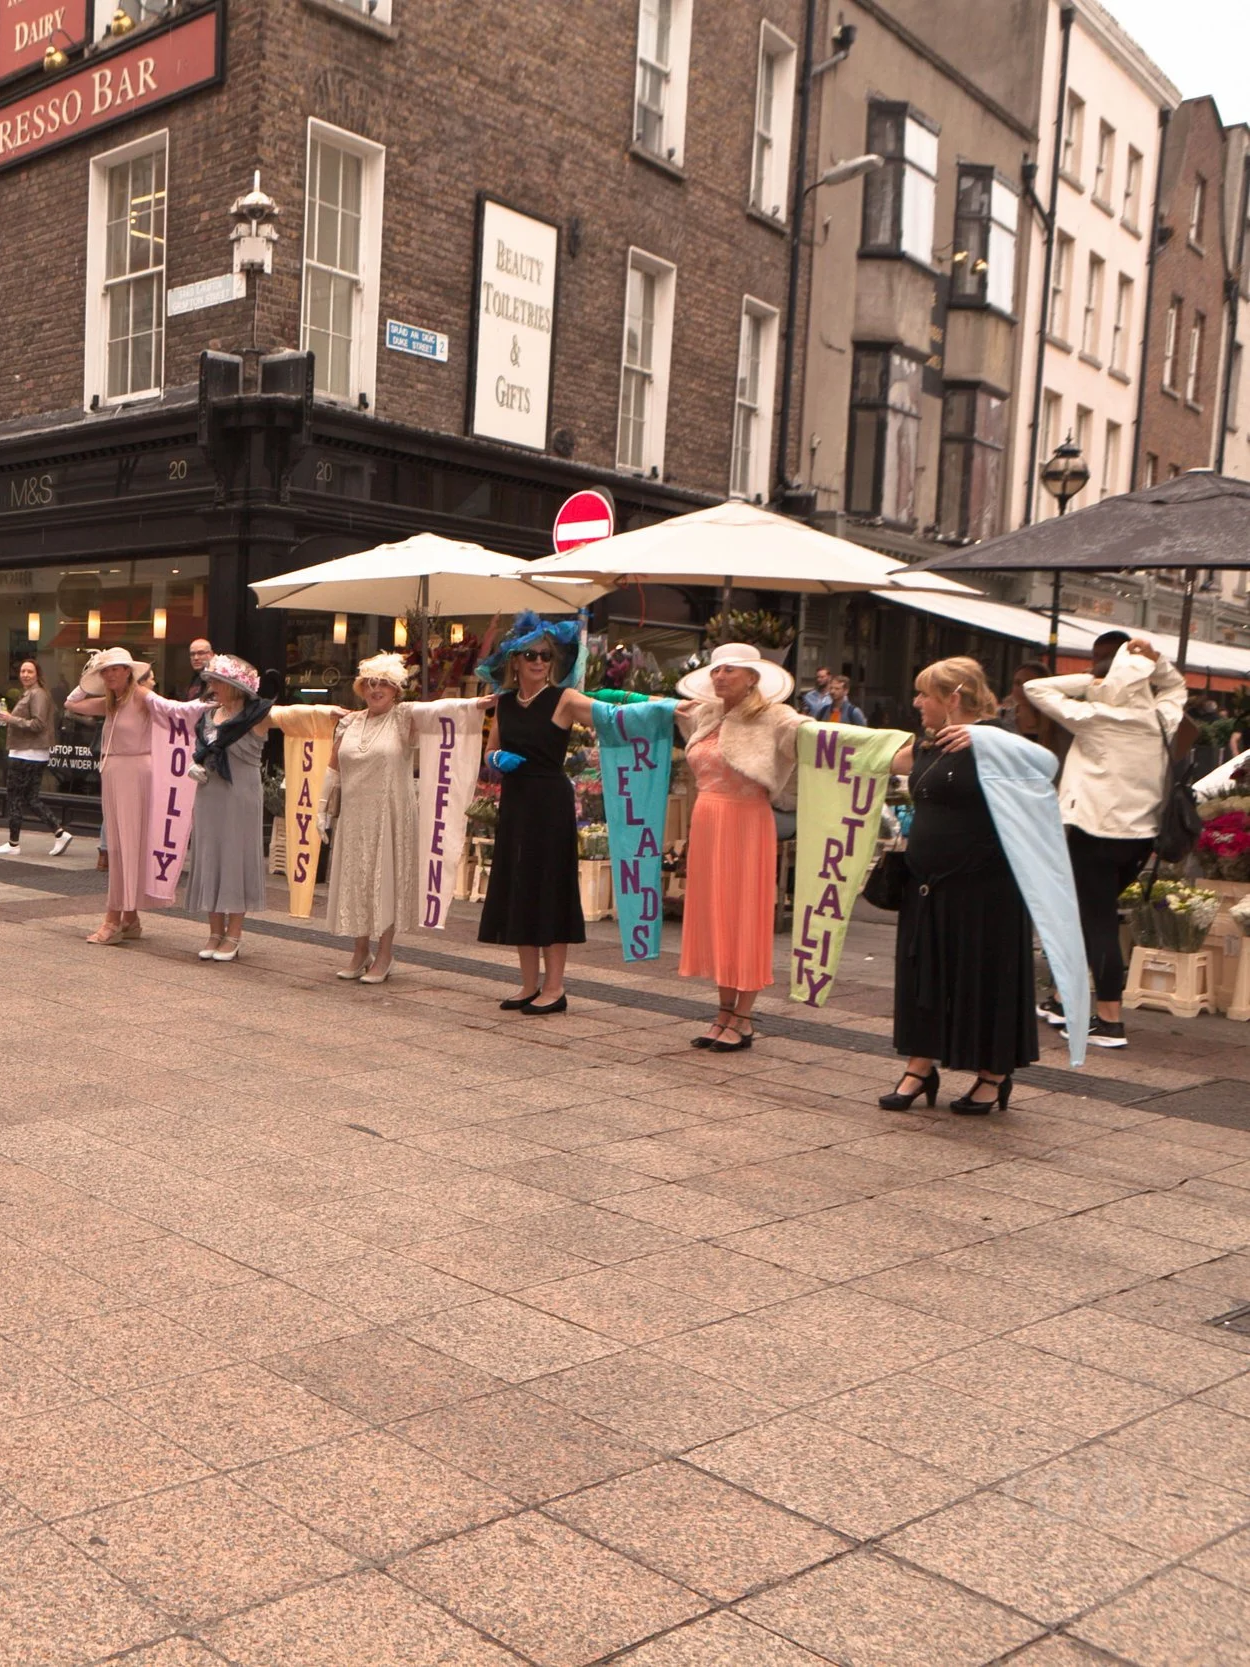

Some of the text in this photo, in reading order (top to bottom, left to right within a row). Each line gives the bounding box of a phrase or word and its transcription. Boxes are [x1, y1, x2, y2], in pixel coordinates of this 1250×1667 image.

[14, 7, 65, 52] DAIRY
[91, 57, 158, 116] BAR
[496, 238, 544, 286] BEAUTY
[483, 280, 551, 335] TOILETRIES
[392, 335, 433, 354] DUKE STREET
[439, 341, 445, 354] 2
[509, 334, 521, 368] &
[495, 375, 531, 414] GIFTS
[168, 460, 187, 480] 20
[316, 460, 333, 482] 20
[10, 474, 53, 509] M&S
[47, 757, 61, 768] JOY
[62, 758, 69, 768] A
[70, 759, 92, 770] WIDER
[49, 744, 73, 755] OFTOP
[153, 717, 190, 882] MOLLY
[294, 741, 314, 883] SAYS
[424, 716, 456, 928] DEFEND
[616, 710, 660, 959] IRELANDS
[792, 729, 876, 1008] NEUTRALITY
